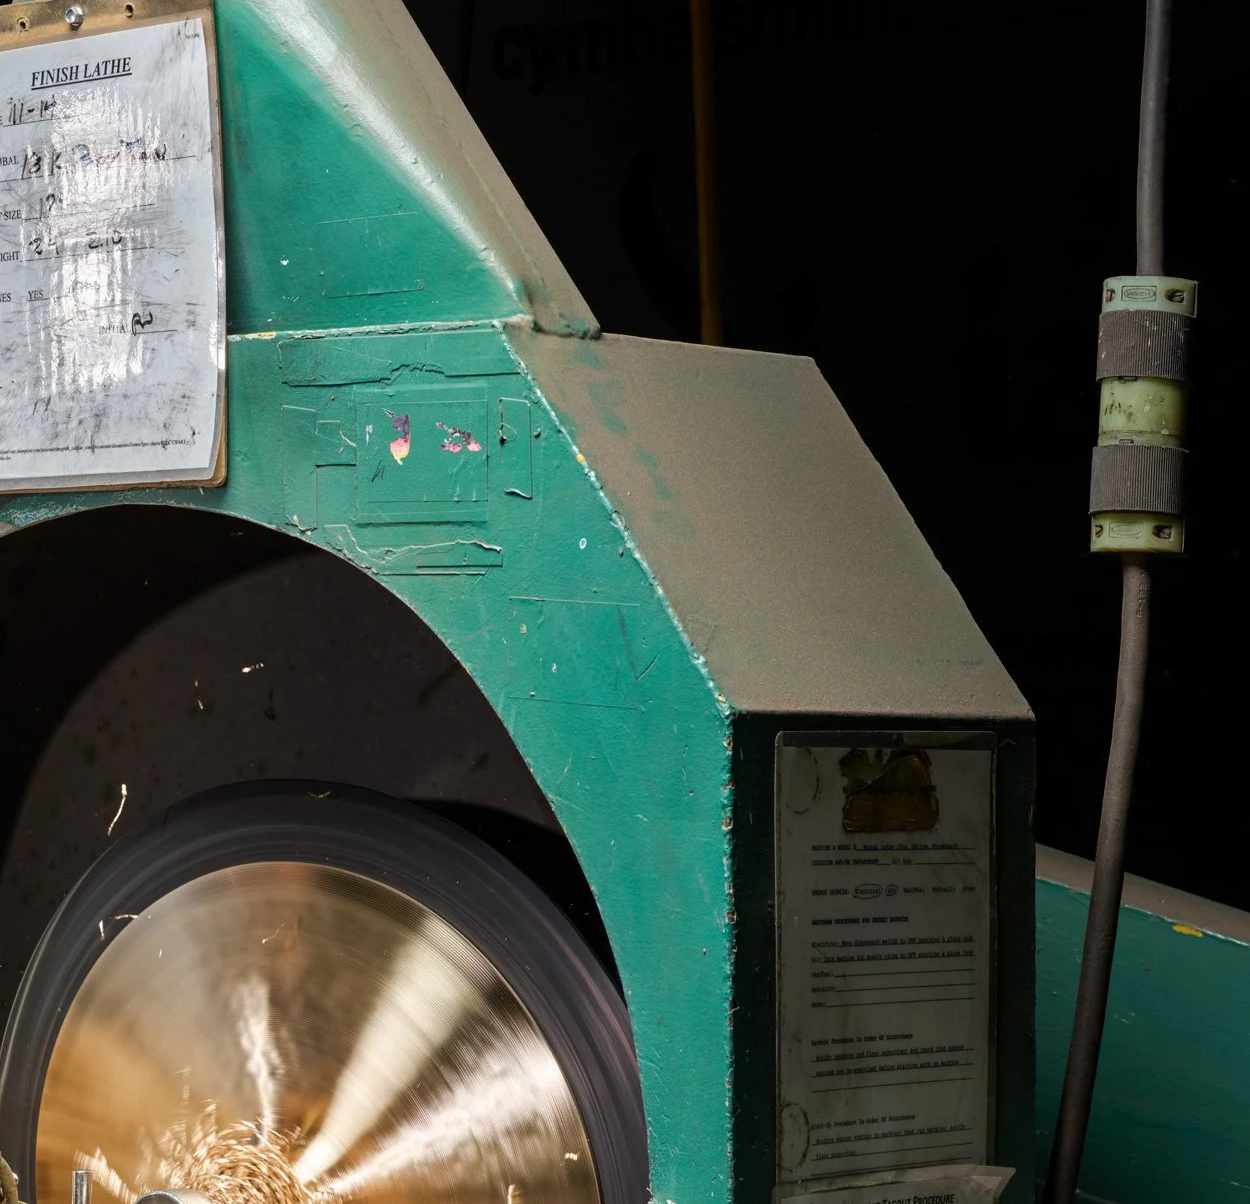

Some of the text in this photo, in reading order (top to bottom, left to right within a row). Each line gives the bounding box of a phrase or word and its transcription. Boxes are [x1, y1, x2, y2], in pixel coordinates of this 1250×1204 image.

[31, 57, 132, 88] FINISH LATHE
[3, 210, 23, 221] SIZE
[28, 290, 44, 301] YES
